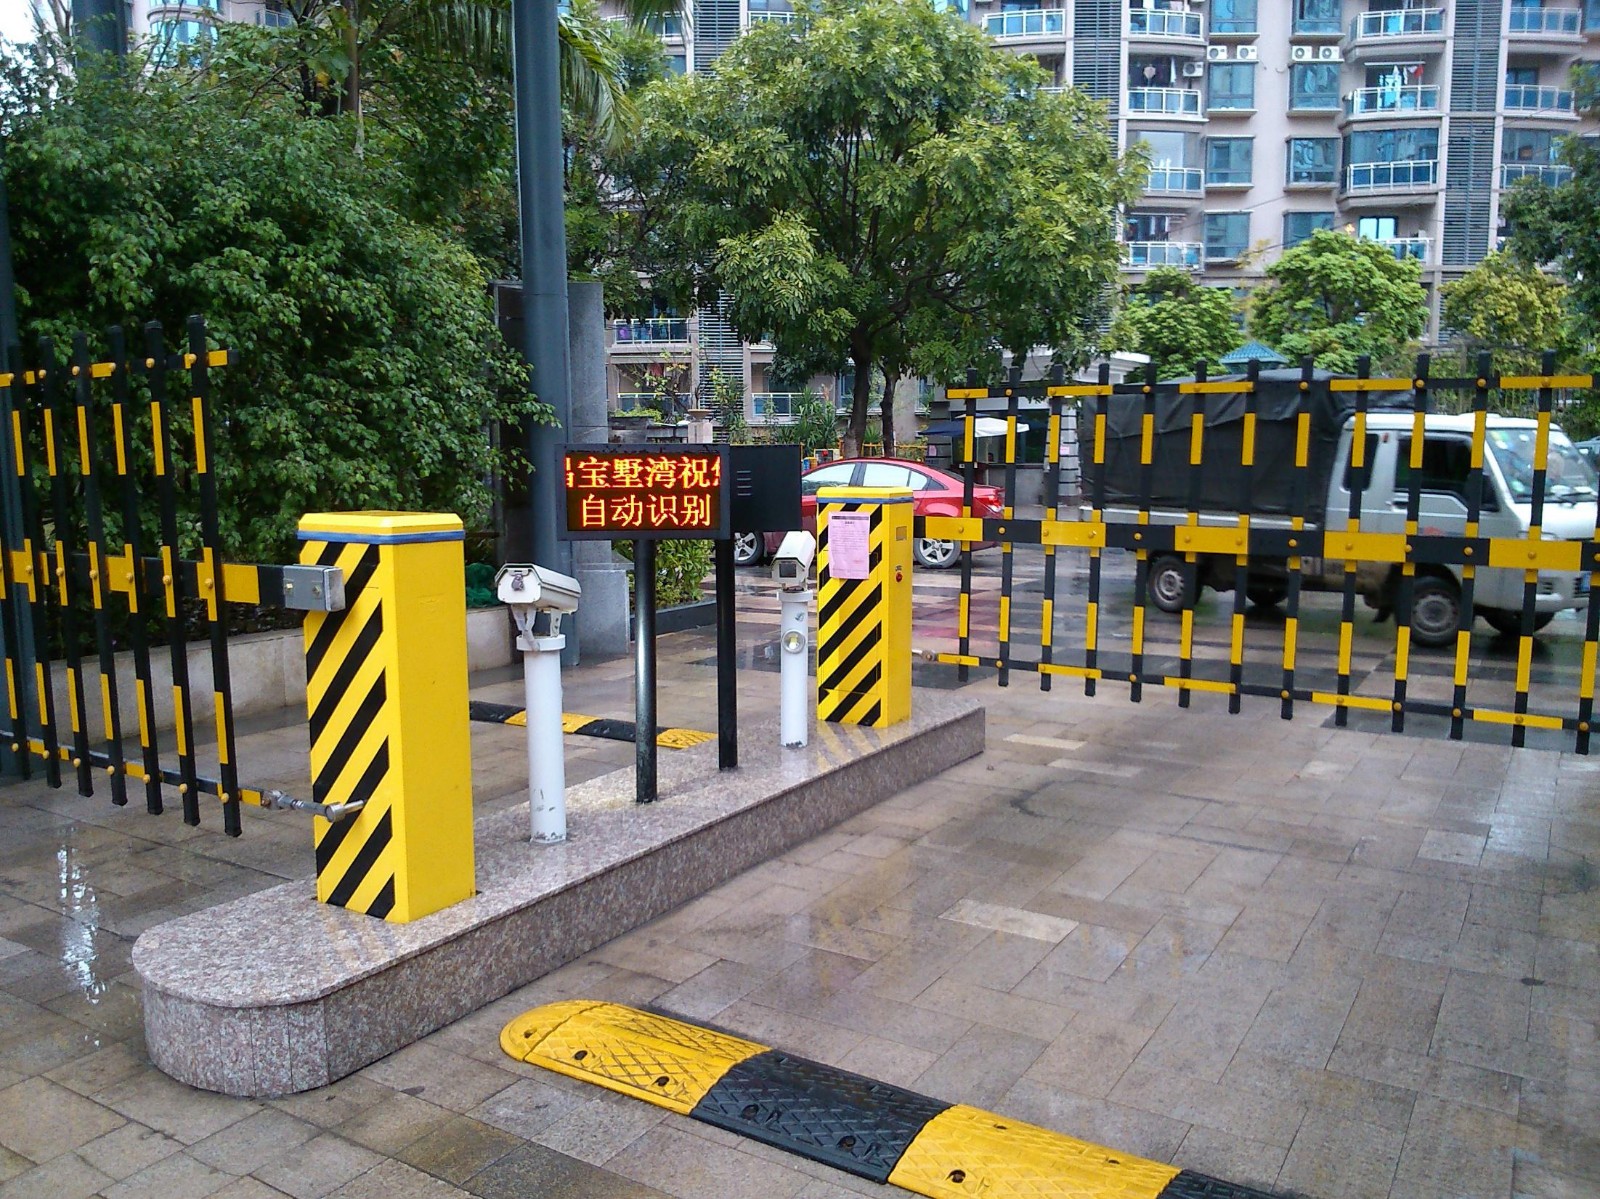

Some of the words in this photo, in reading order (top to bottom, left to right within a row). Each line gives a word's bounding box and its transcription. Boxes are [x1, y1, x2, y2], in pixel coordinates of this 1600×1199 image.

[565, 456, 721, 489] 宝墅湾祝
[582, 493, 711, 527] 自动识别
